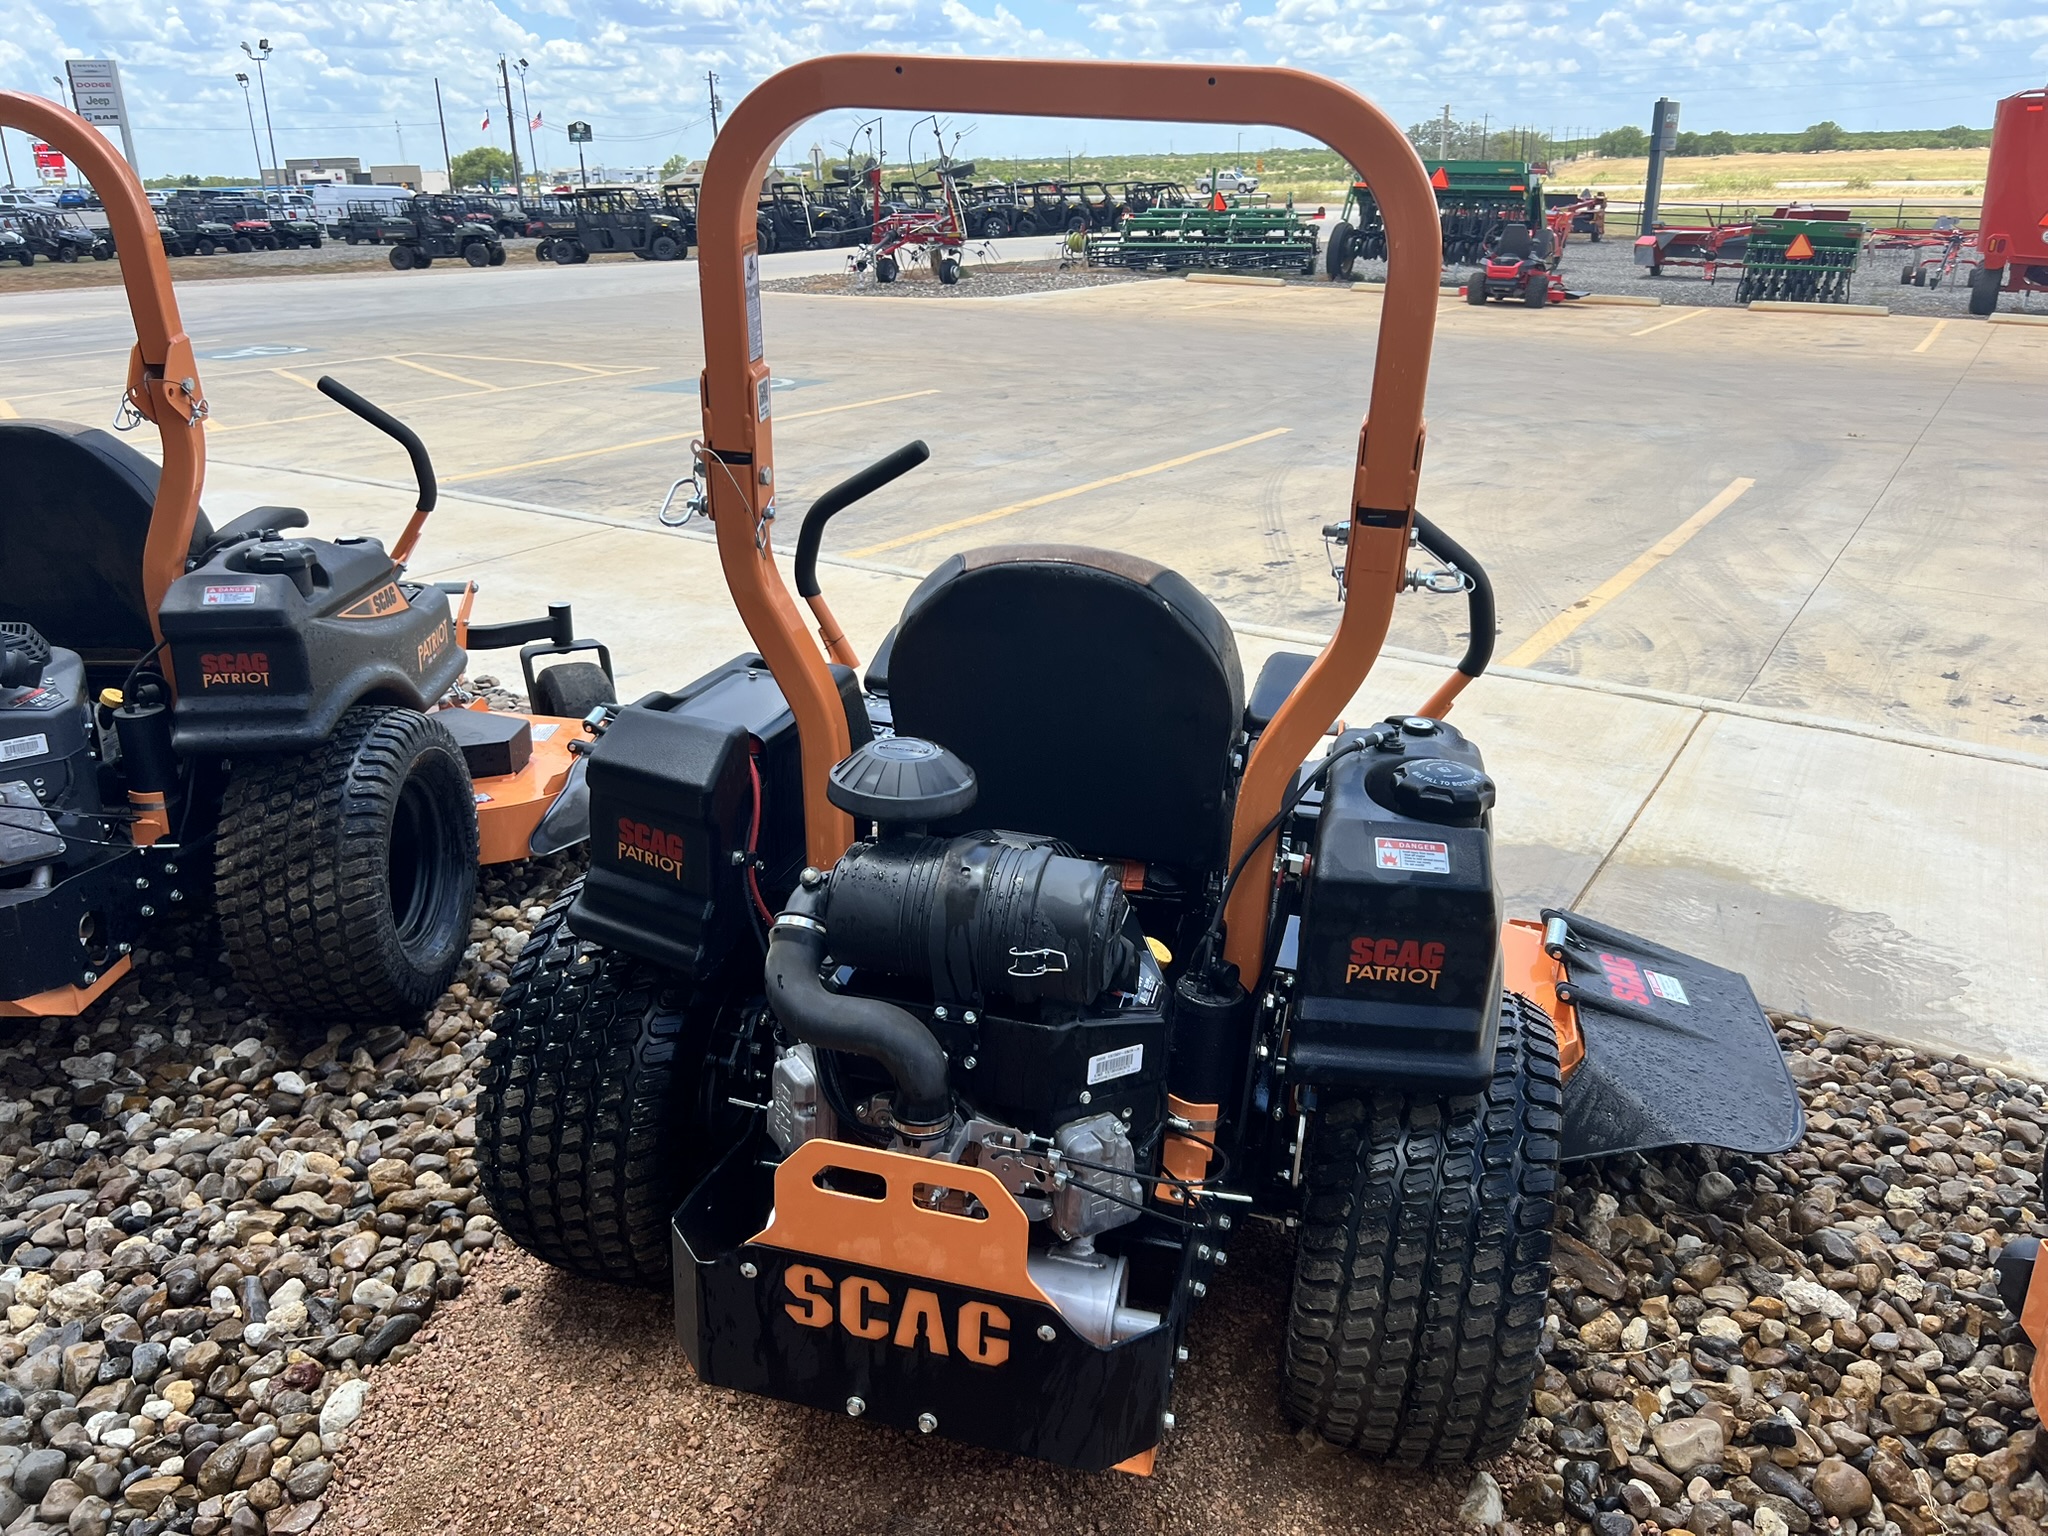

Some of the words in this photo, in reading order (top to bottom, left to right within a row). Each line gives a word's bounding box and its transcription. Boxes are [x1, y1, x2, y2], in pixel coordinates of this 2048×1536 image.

[86, 96, 110, 106] Jeep
[372, 586, 397, 614] SCAG
[417, 618, 449, 673] PATRIOT
[201, 653, 269, 673] SCAG
[203, 672, 269, 689] PATRIOT
[1423, 776, 1437, 785] FILL
[618, 817, 684, 861] SCAG
[1399, 842, 1437, 851] DANGER
[618, 841, 683, 880] PATRIOT
[1350, 937, 1446, 969] SCAG
[1345, 964, 1441, 990] PATRIOT
[1599, 953, 1650, 1006] SCAG
[785, 1264, 1011, 1367] SCAG
